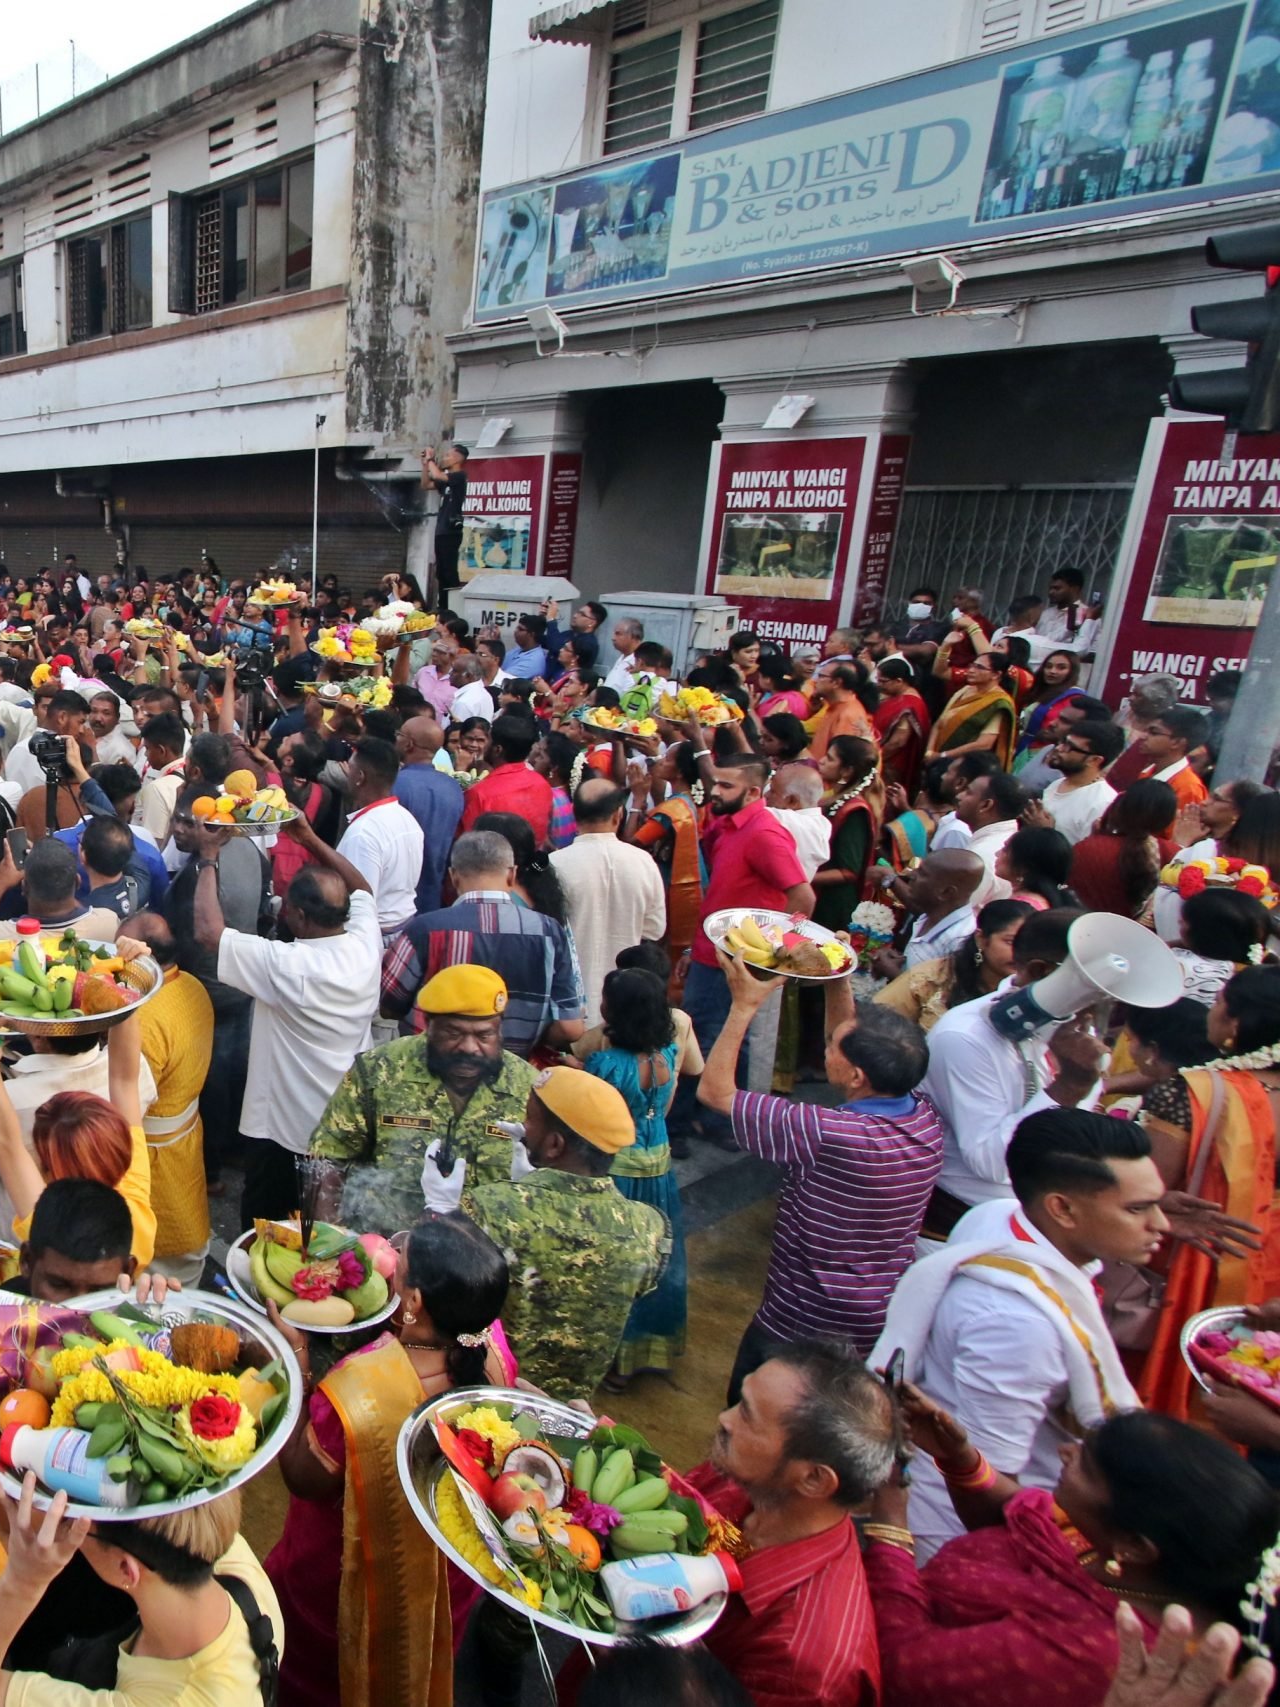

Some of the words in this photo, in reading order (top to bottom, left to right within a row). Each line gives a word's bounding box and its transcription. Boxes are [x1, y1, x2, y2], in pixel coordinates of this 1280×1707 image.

[691, 153, 743, 177] S.M.
[686, 117, 971, 236] BADJENID
[736, 202, 766, 224] &
[775, 179, 878, 217] sons
[466, 481, 495, 495] INYAK
[497, 480, 532, 495] WANGI
[731, 470, 790, 488] MINYAK
[793, 468, 847, 487] WANGI
[485, 497, 533, 511] ALKOHOL
[726, 491, 770, 508] TANPA
[774, 489, 847, 507] ALKOHOL
[1173, 486, 1252, 508] TANPA
[756, 620, 828, 642] SEHARIAN
[1132, 650, 1206, 676] WANGI
